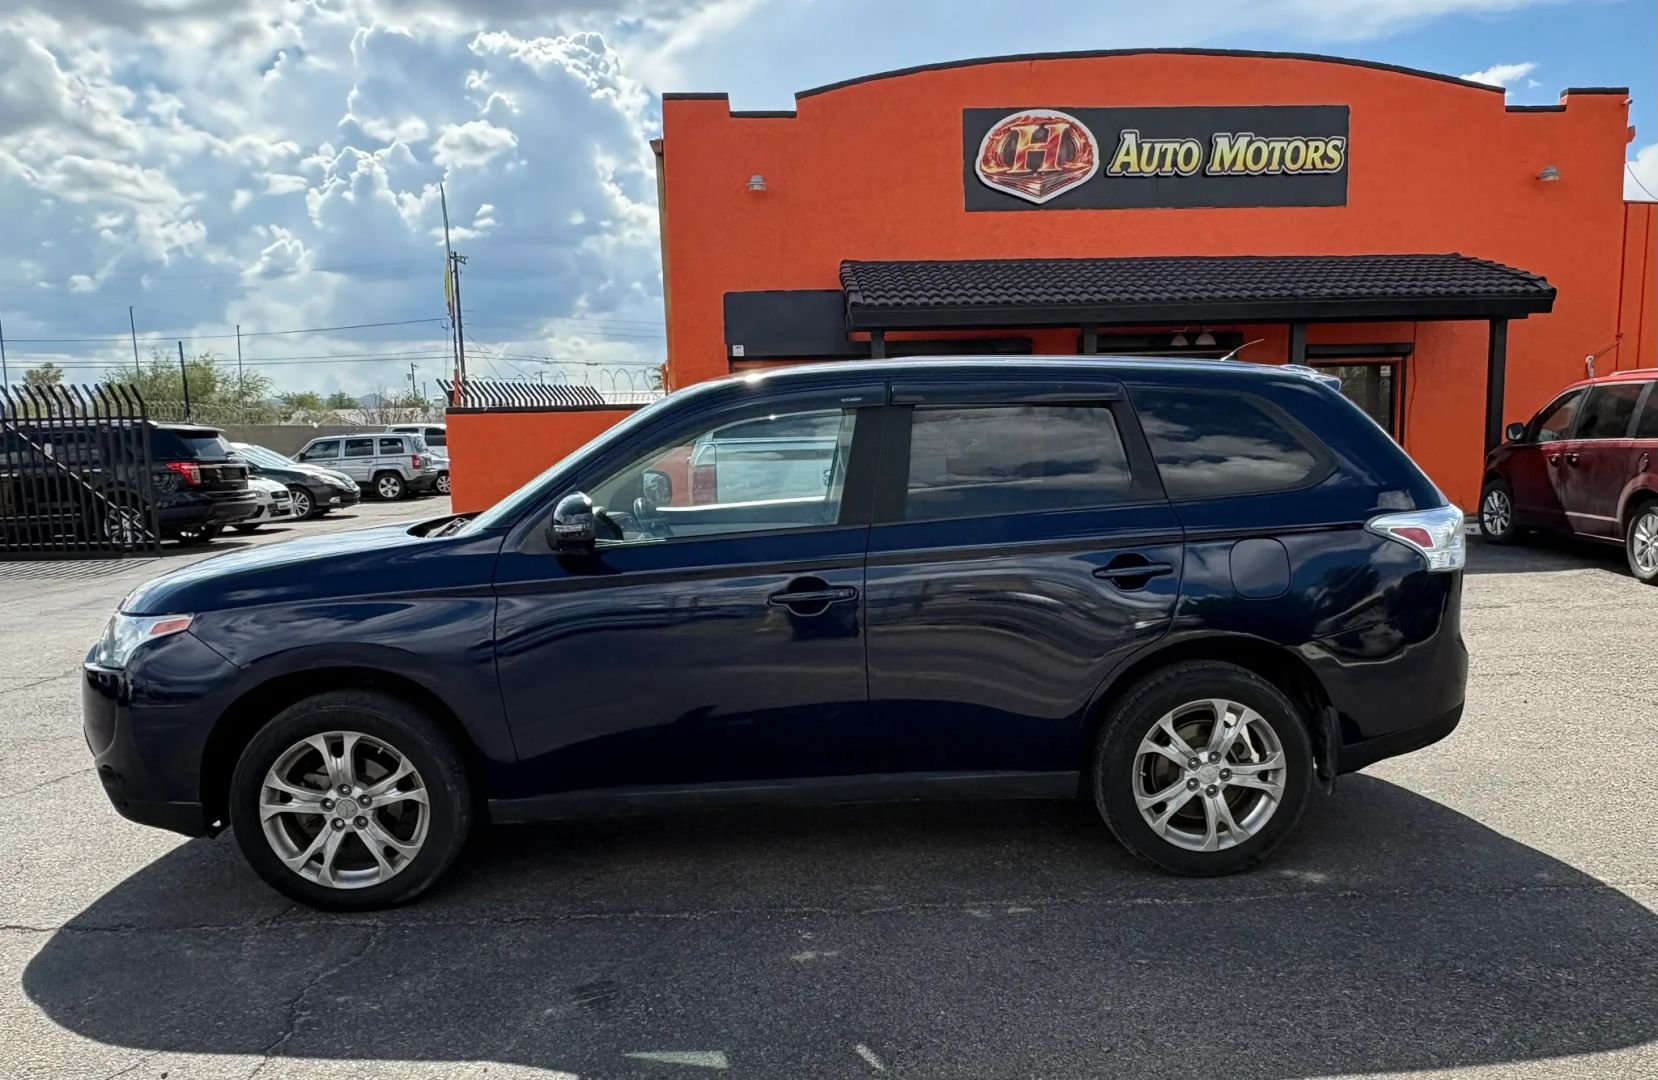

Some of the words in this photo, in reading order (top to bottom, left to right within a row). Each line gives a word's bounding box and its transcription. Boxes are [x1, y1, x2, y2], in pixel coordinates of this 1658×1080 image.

[1006, 123, 1070, 174] H
[1108, 131, 1202, 176] AUTO
[1209, 134, 1345, 175] MOTORS
